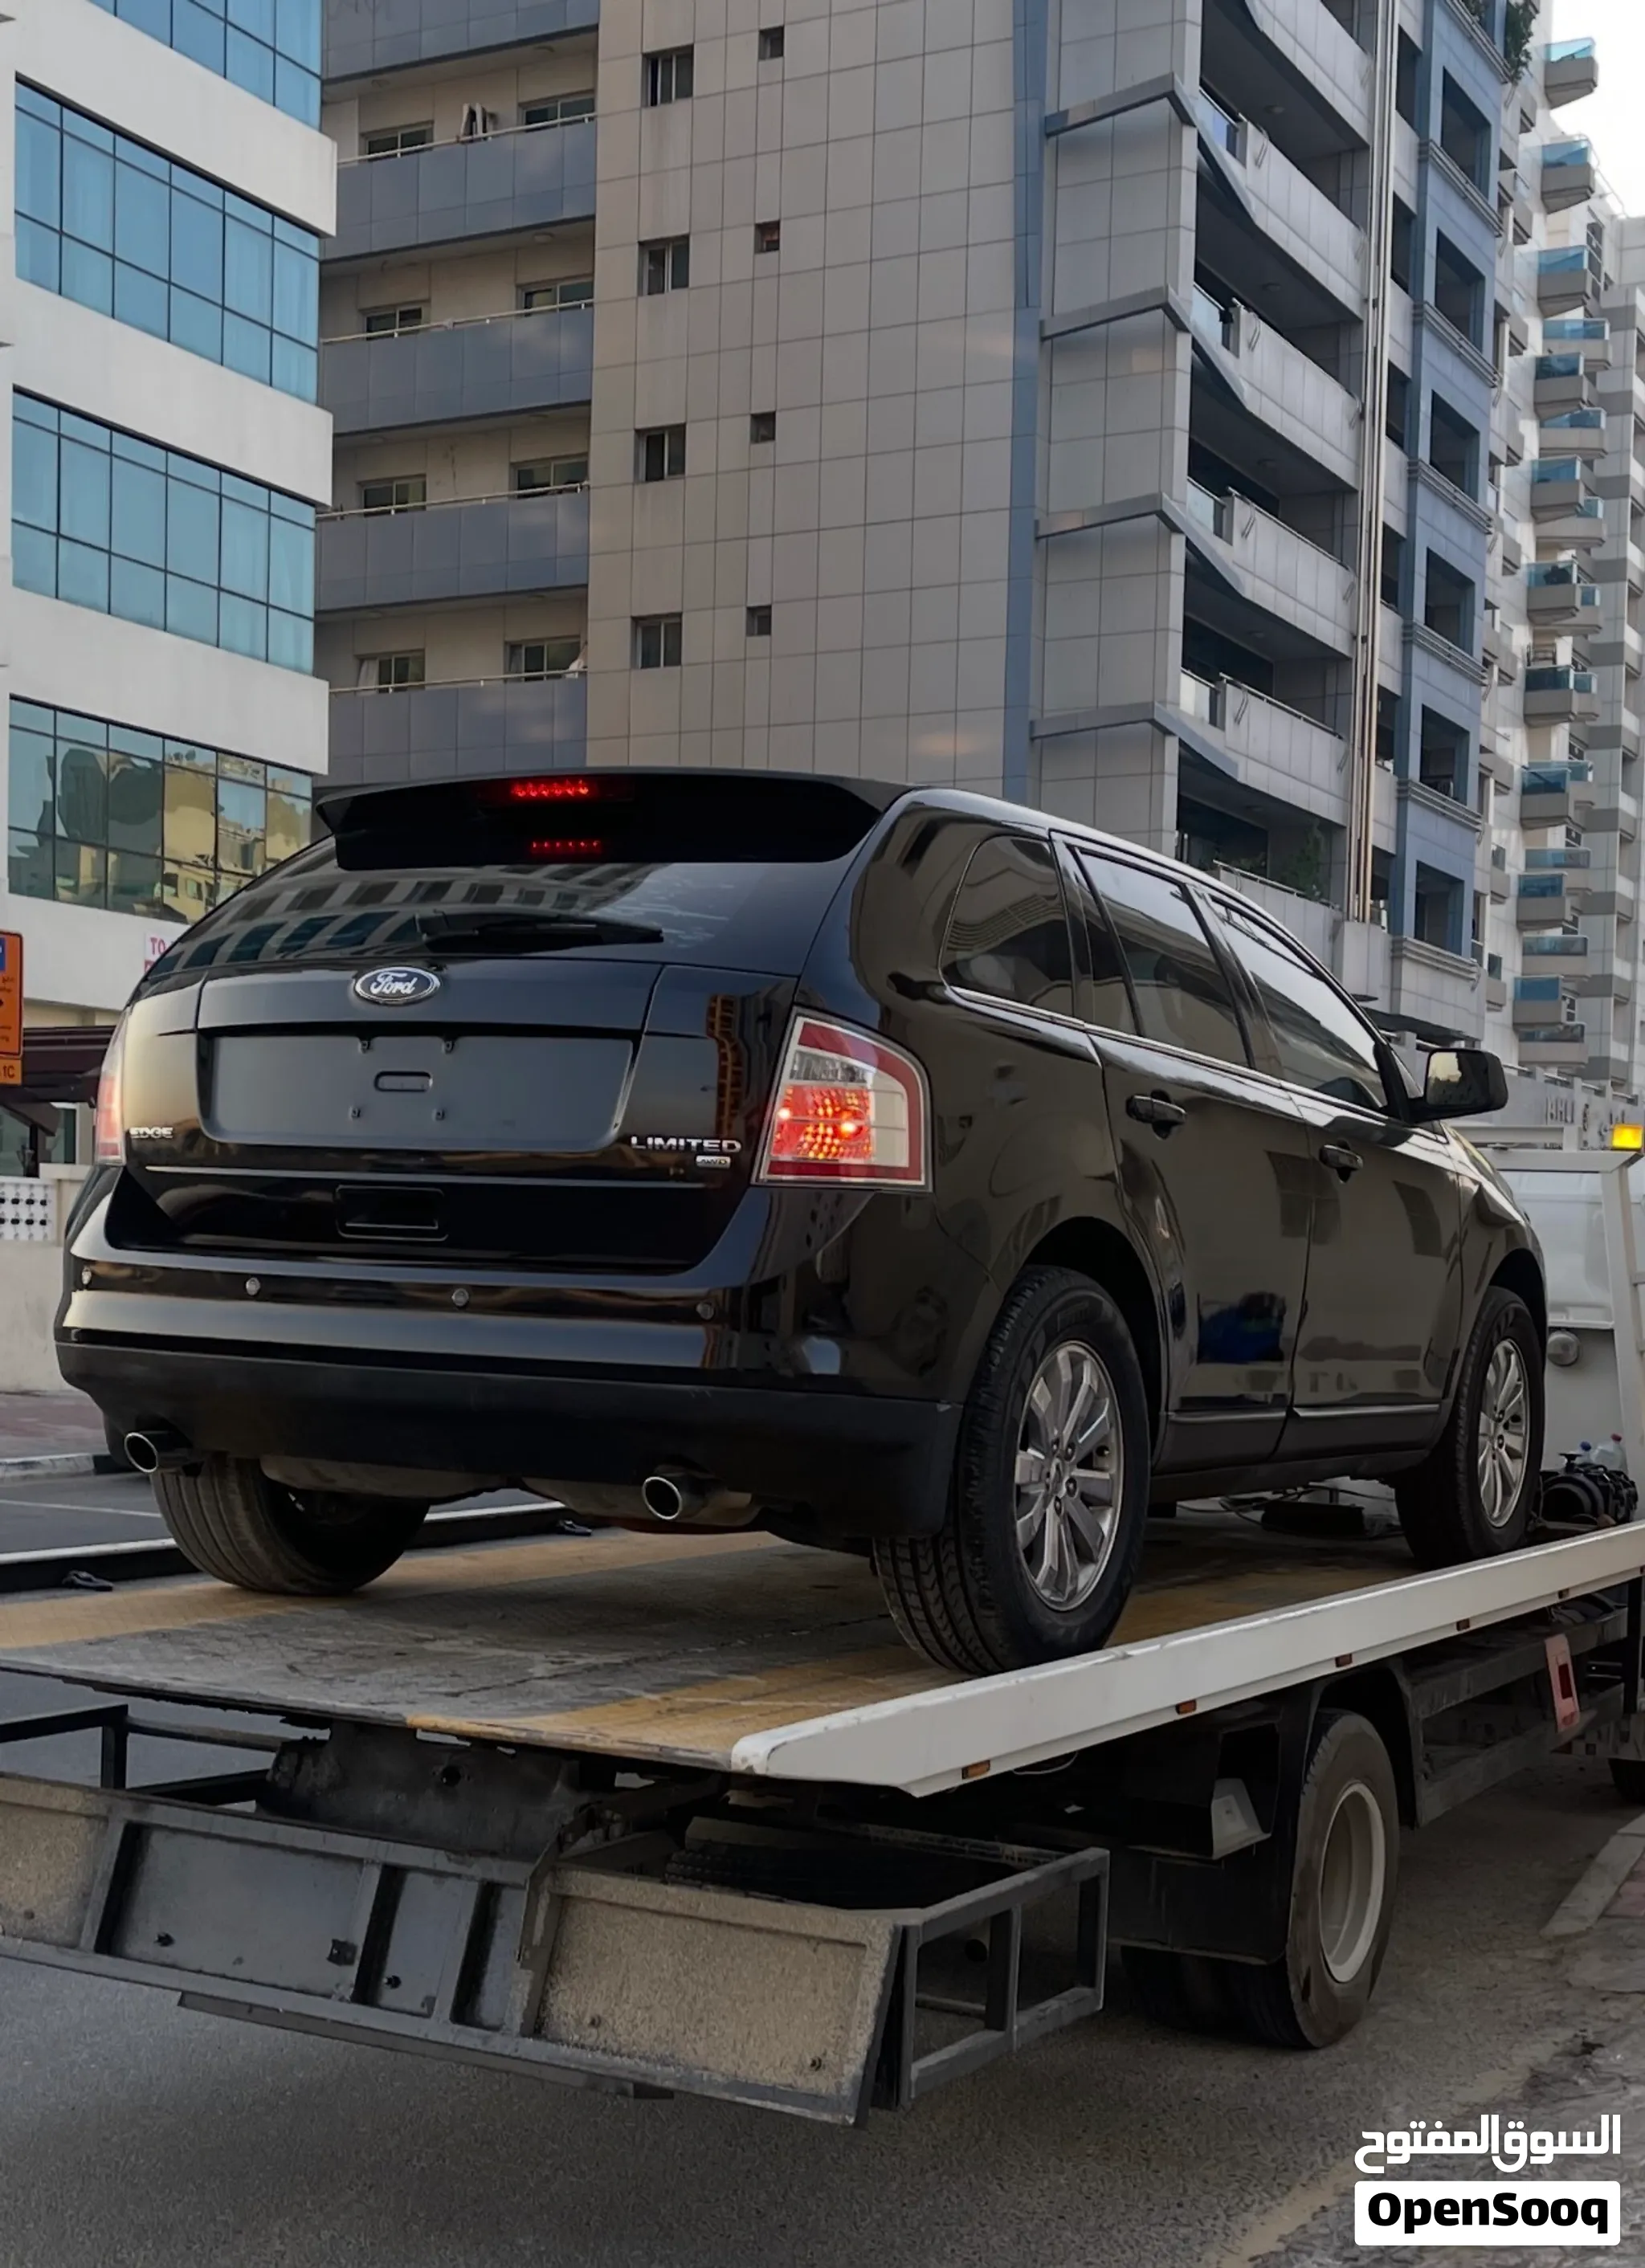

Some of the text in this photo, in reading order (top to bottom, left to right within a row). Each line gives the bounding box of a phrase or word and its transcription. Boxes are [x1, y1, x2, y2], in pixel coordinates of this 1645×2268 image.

[369, 972, 417, 994] Ford
[129, 1127, 173, 1139] EDGE
[631, 1136, 742, 1153] LIMITED
